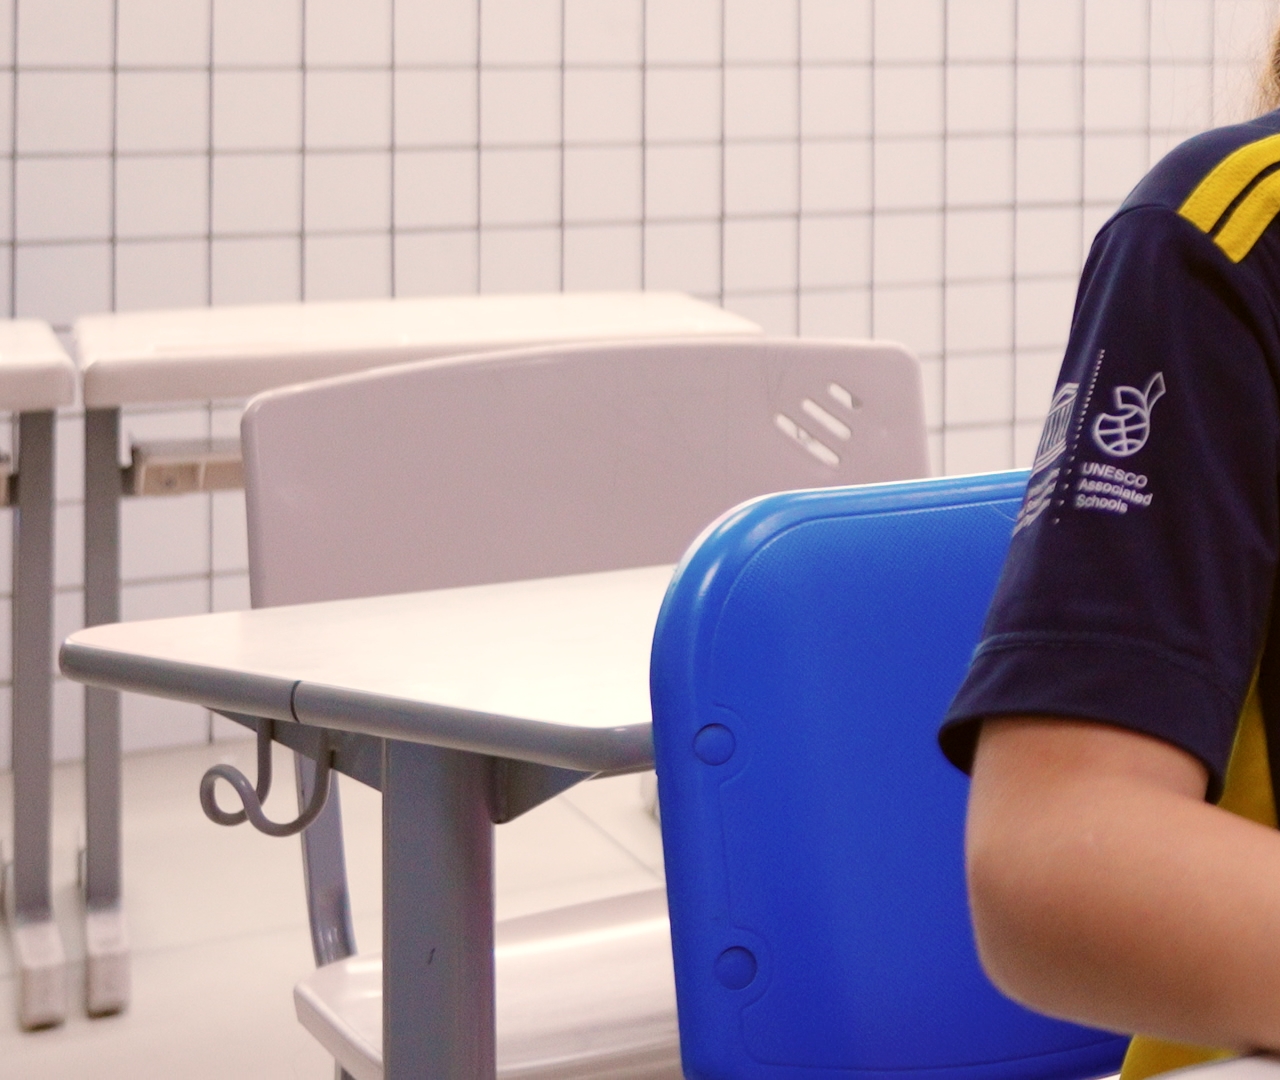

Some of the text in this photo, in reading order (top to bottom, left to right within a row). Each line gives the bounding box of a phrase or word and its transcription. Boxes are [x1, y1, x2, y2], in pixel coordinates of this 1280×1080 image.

[1082, 462, 1148, 489] UNESCO
[1075, 493, 1128, 514] Schools
[1078, 478, 1153, 507] Associated
